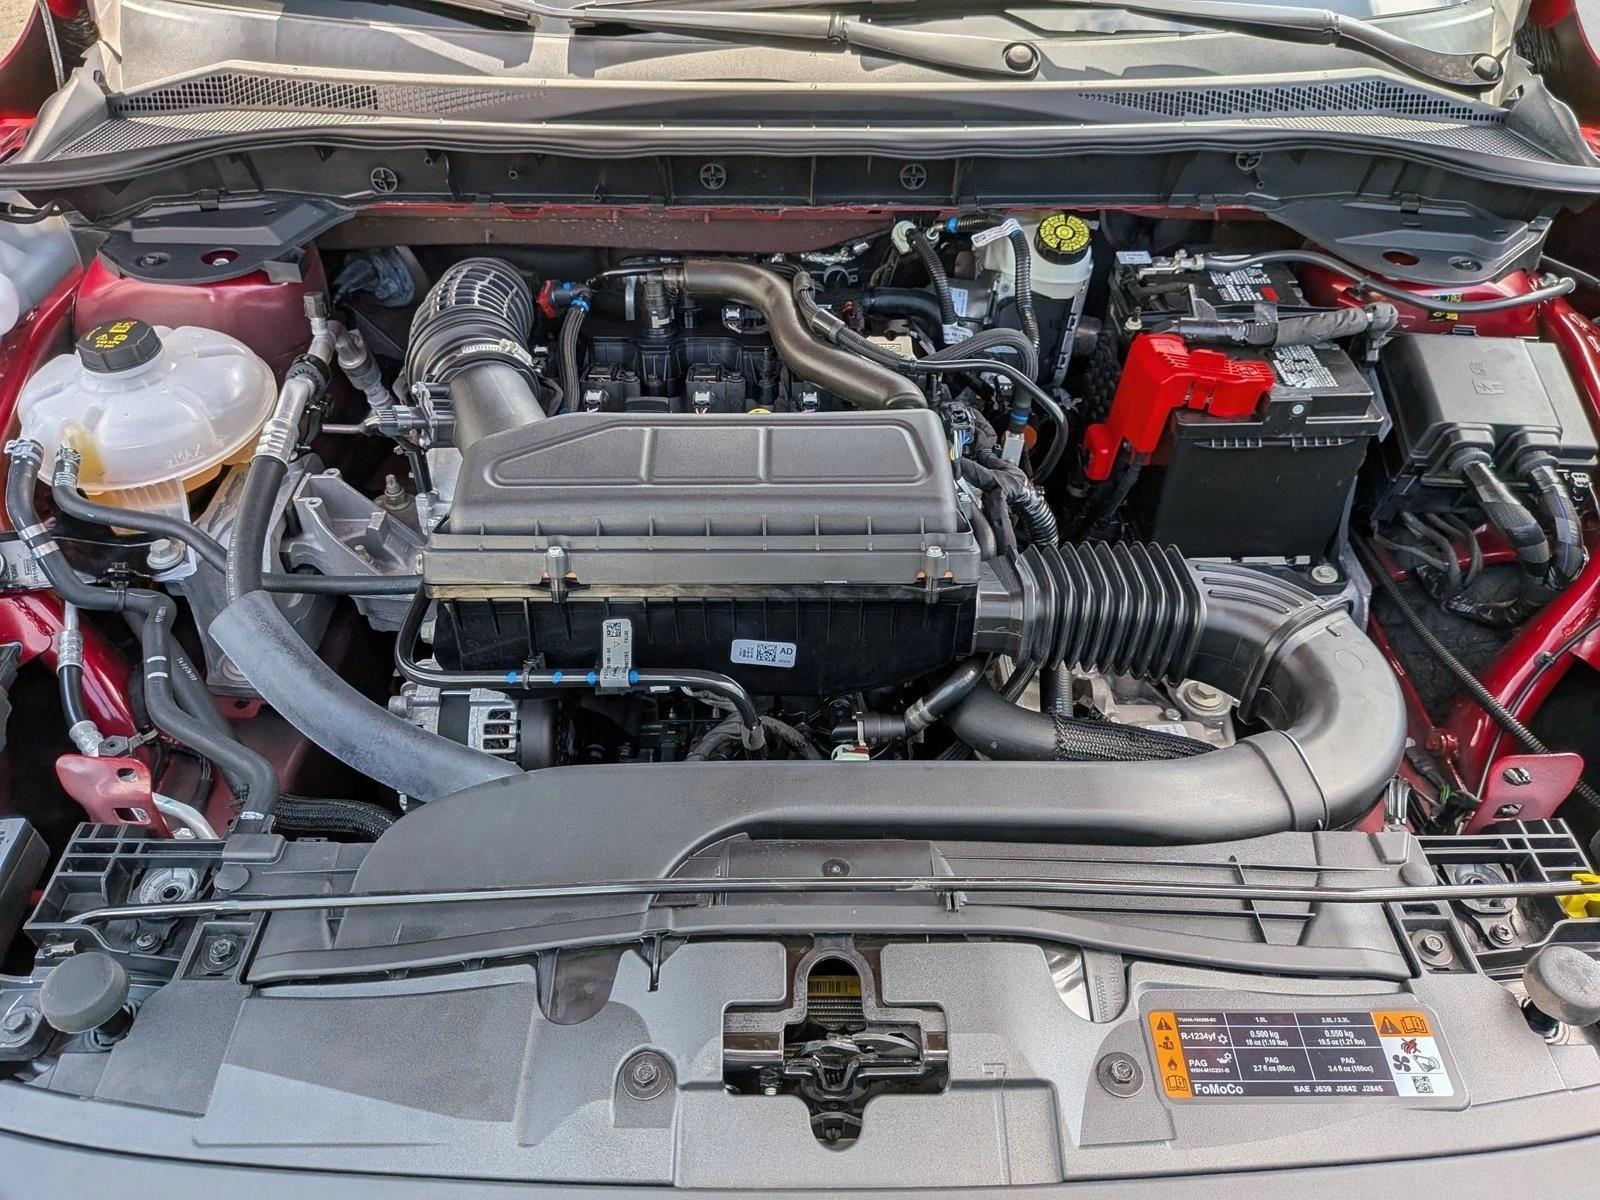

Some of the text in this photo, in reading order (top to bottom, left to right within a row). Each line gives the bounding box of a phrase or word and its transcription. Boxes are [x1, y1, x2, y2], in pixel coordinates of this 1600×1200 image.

[1181, 1032, 1216, 1041] R-1234yf
[1269, 1030, 1279, 1039] kg
[1344, 1030, 1354, 1039] kg
[1352, 1065, 1374, 1073] (100cc)
[1194, 1083, 1243, 1094] FoMoCo
